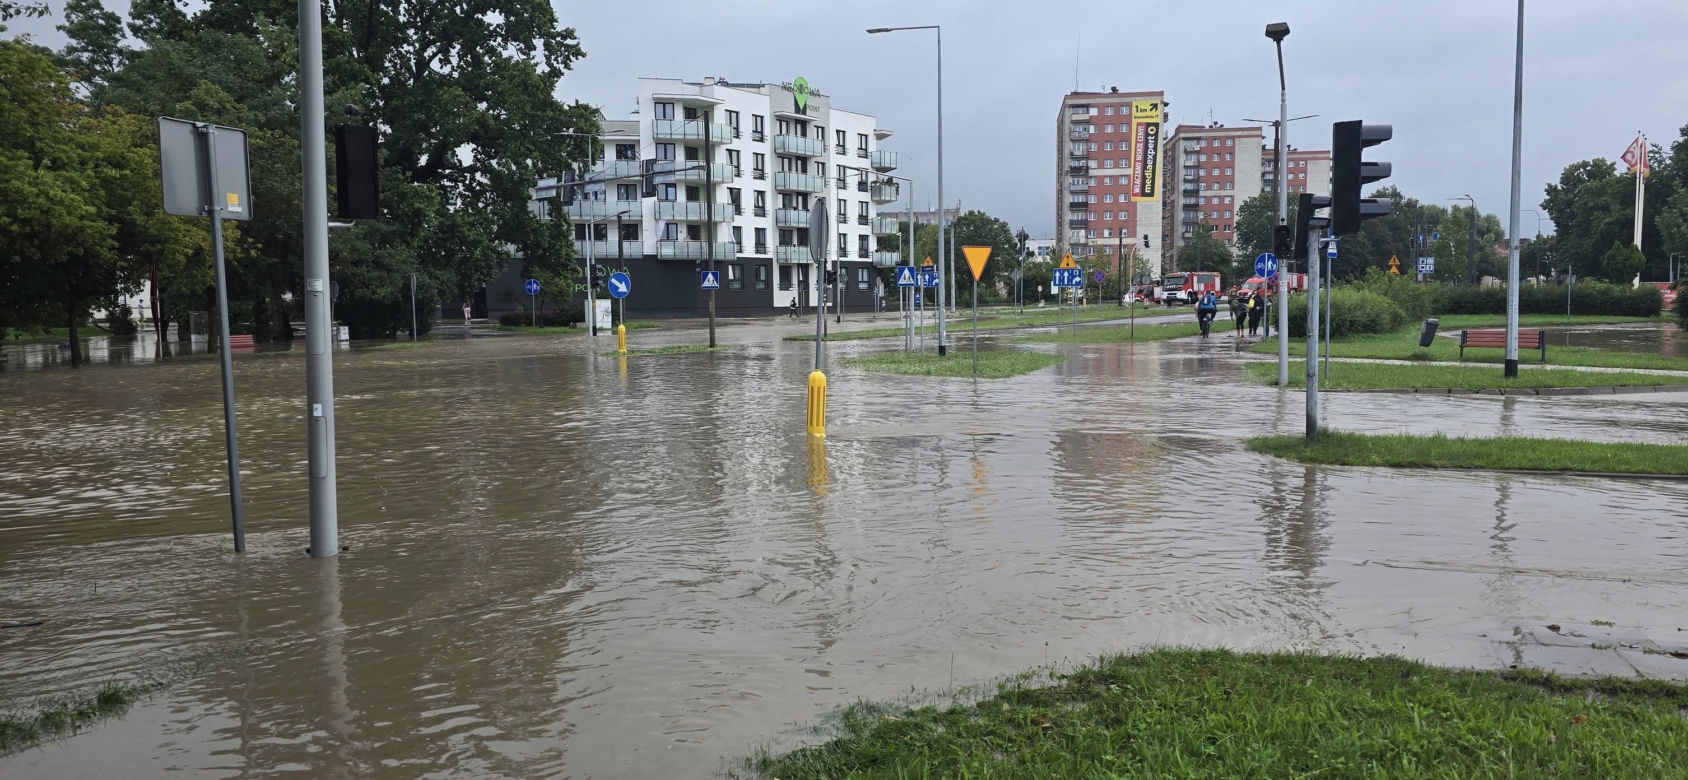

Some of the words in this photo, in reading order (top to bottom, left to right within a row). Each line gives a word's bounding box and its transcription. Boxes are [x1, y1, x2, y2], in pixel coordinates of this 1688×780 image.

[1135, 105, 1139, 113] 1
[1137, 125, 1145, 142] CENY!
[1136, 143, 1144, 161] NISKIE
[1144, 135, 1155, 193] mediaexpert
[1133, 162, 1141, 193] WŁĄCZAMY
